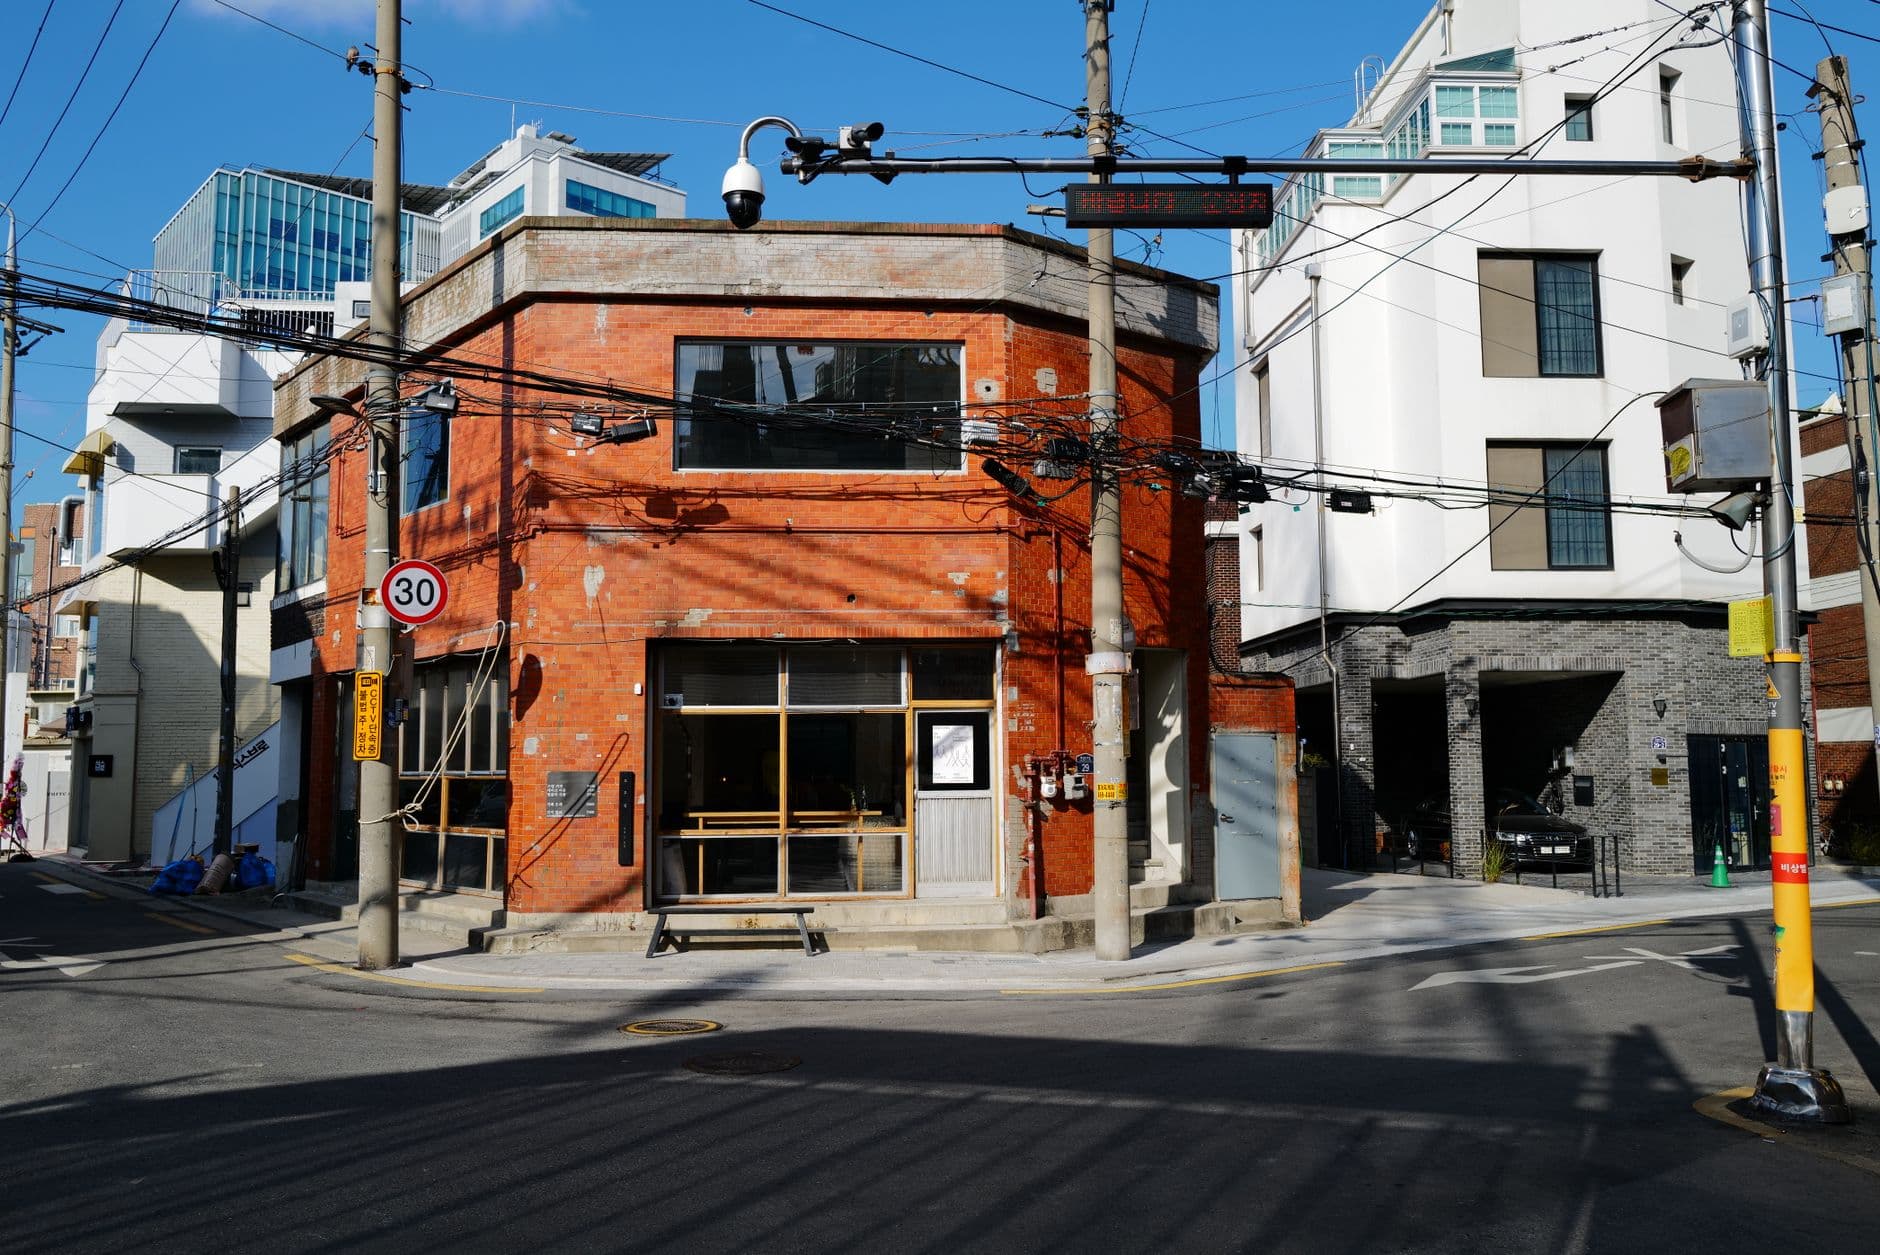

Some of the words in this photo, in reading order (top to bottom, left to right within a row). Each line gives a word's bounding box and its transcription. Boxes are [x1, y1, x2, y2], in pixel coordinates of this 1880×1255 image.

[395, 577, 435, 607] 30
[359, 690, 368, 712] 불법
[1081, 763, 1090, 772] 29
